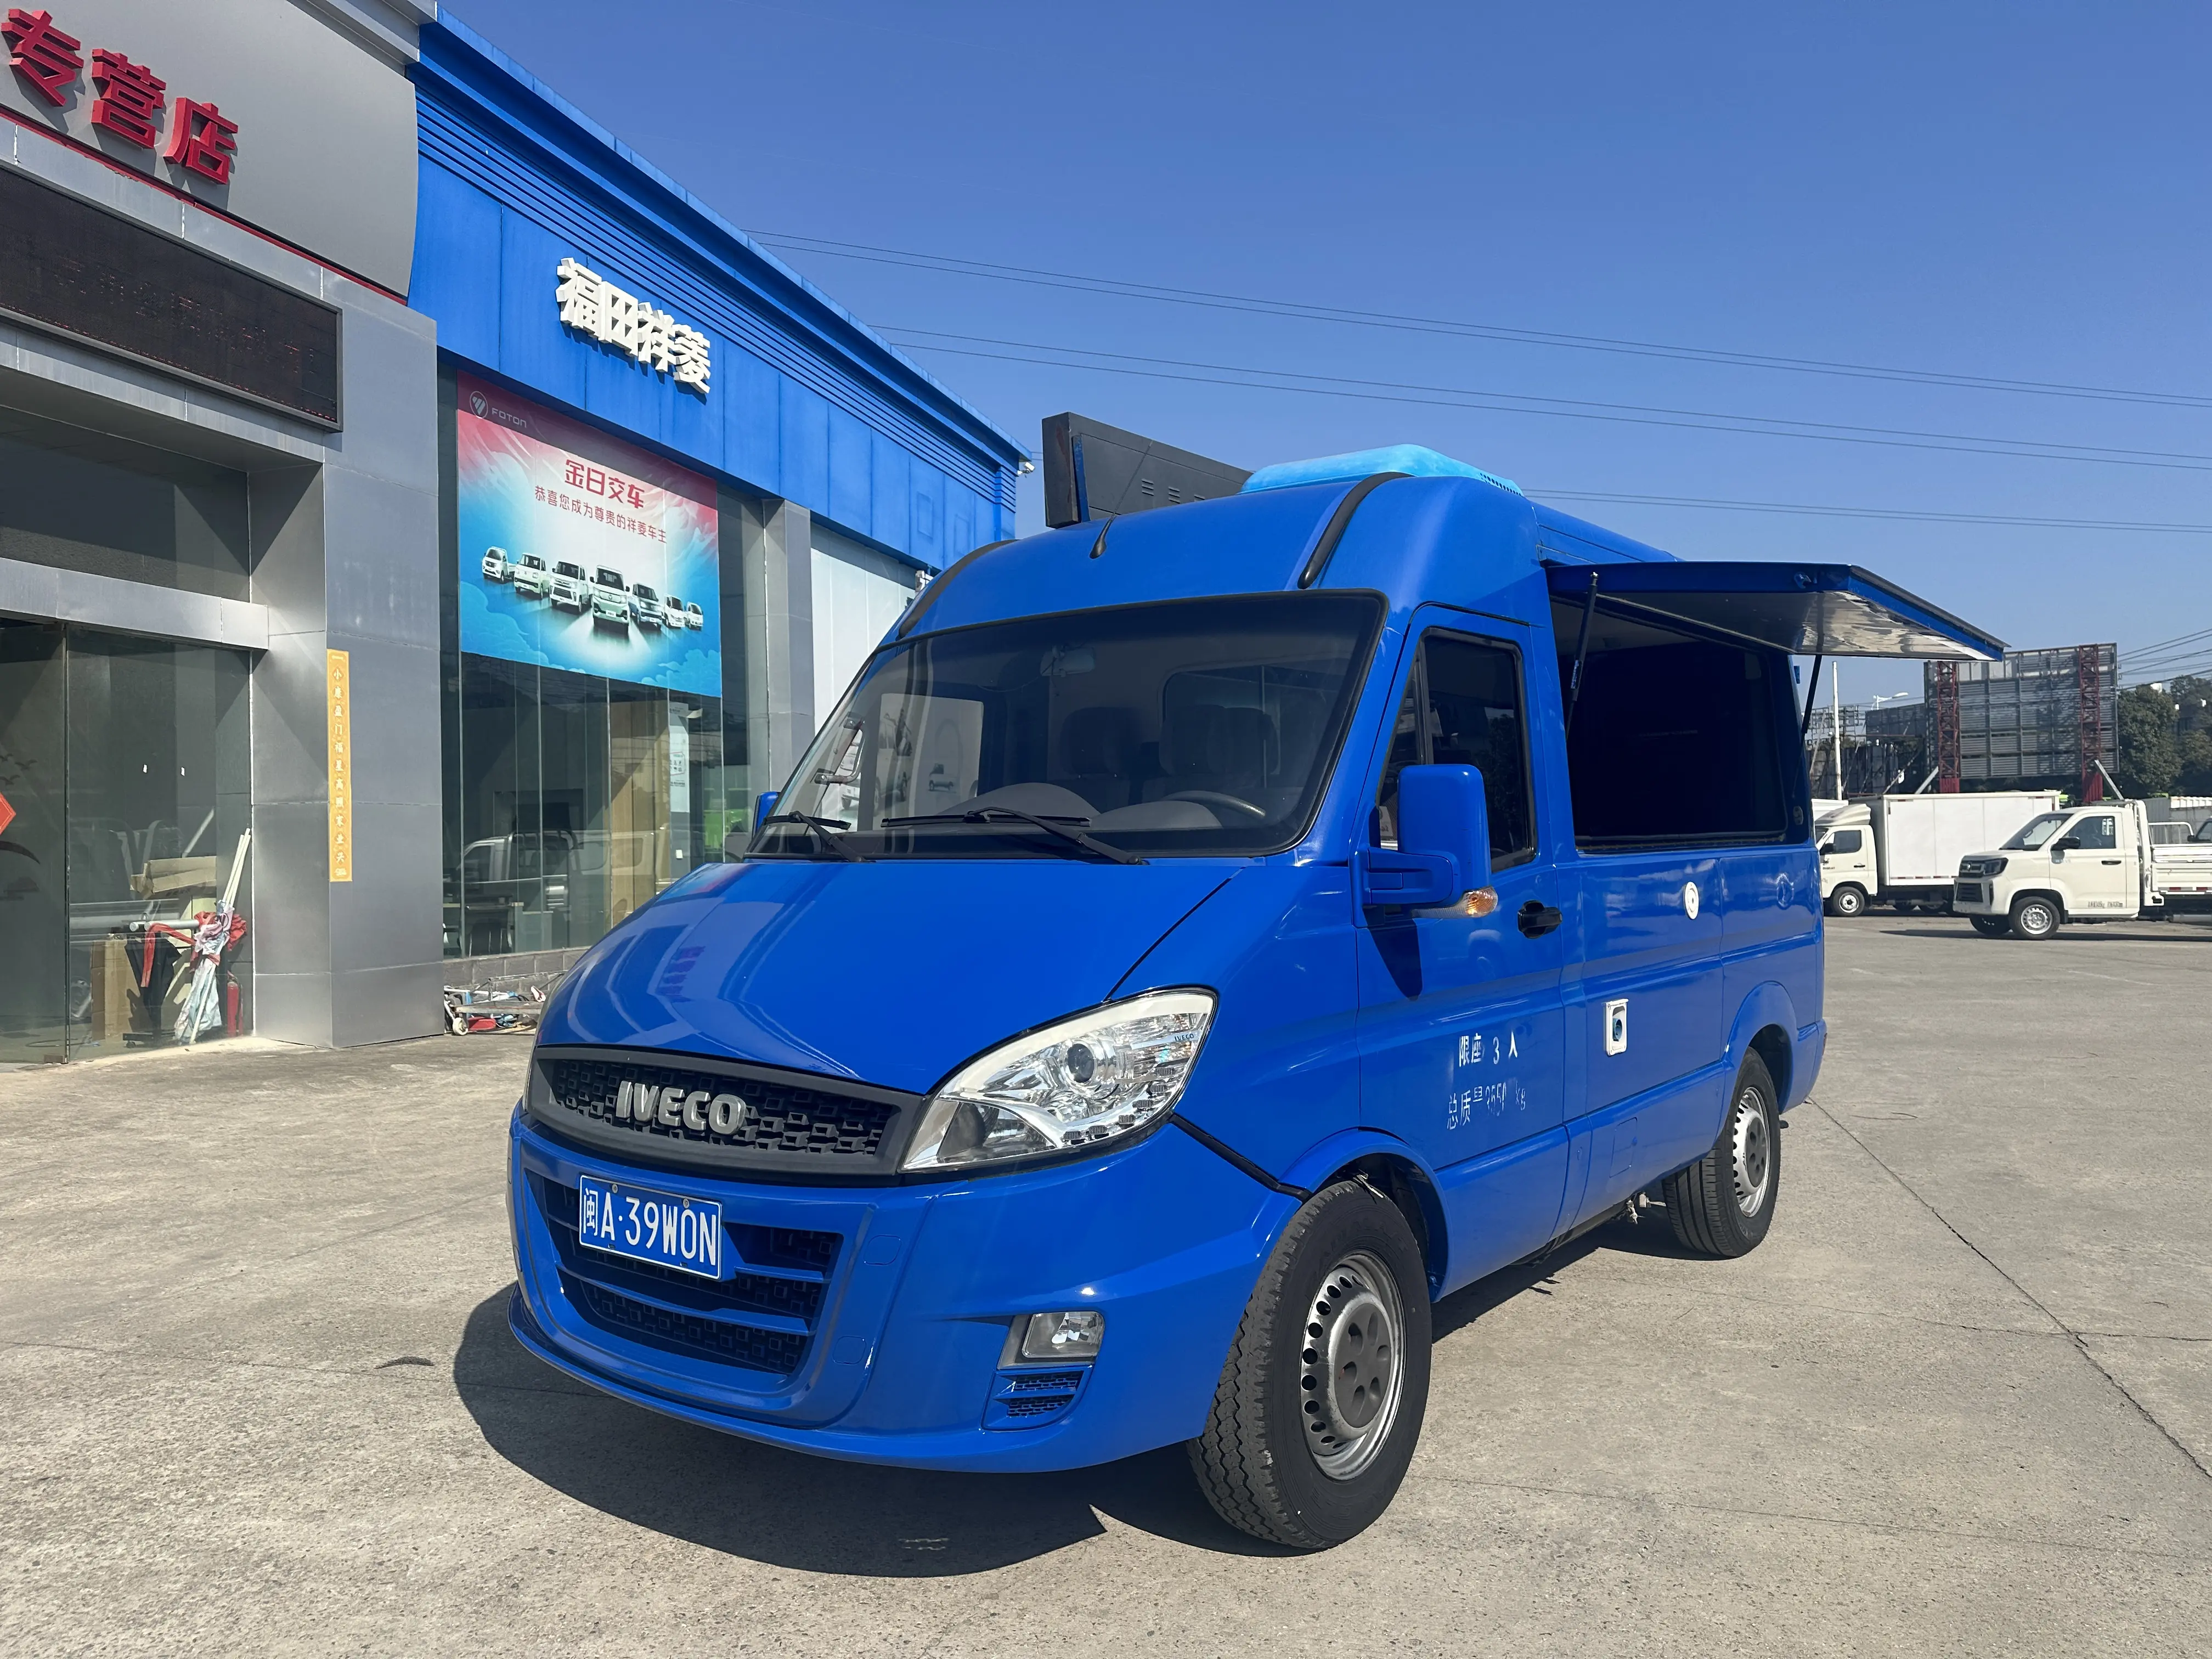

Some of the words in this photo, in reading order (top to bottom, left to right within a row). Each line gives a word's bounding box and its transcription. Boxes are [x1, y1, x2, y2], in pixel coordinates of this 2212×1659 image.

[1, 8, 238, 185] 专营店
[555, 257, 711, 393] 福田祥菱
[492, 407, 527, 428] FOTON
[565, 459, 645, 509] 金日交车
[534, 485, 667, 544] 恭喜您成为尊贵的祥菱车主
[1174, 1033, 1194, 1042] IVECO
[1493, 1036, 1500, 1065] 3
[1508, 1030, 1518, 1059] 人
[616, 1080, 746, 1135] IVECO
